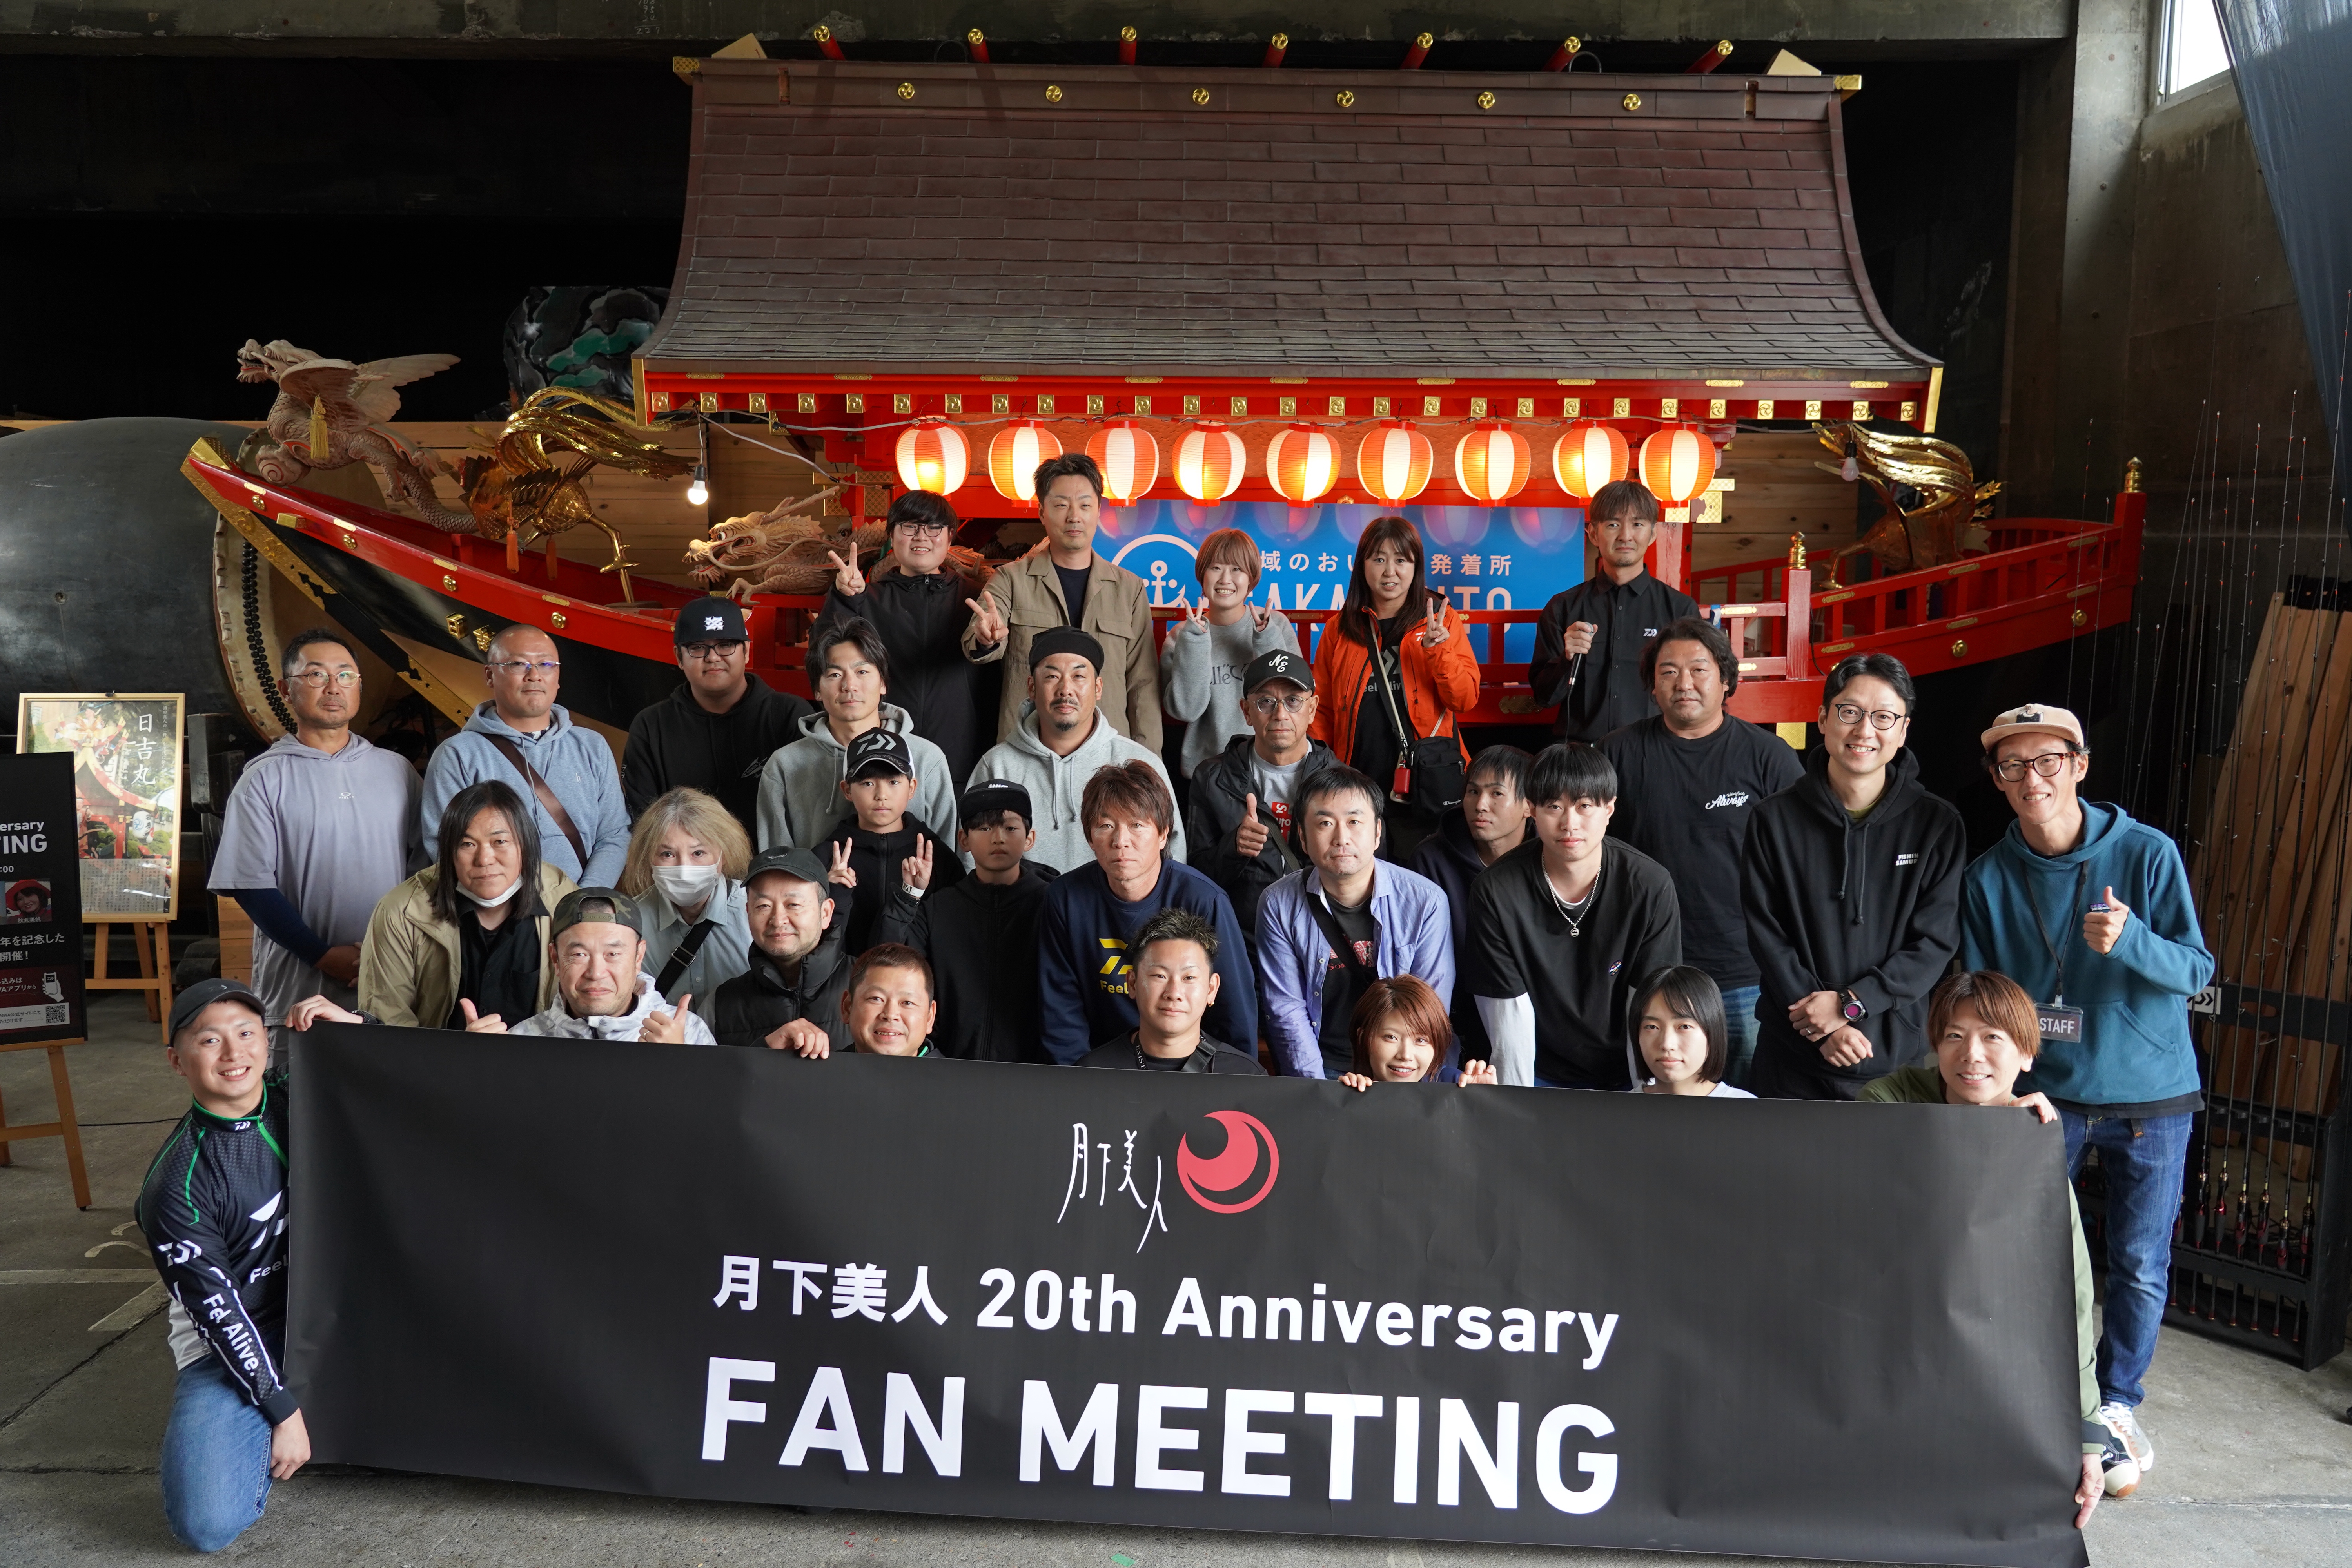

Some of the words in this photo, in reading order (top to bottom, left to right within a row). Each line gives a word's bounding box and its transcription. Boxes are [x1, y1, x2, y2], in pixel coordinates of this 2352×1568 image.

[1431, 554, 1512, 576] 発着所
[131, 713, 157, 785] 日吉丸
[1705, 794, 1749, 810] Always
[0, 833, 47, 854] ING
[0, 933, 65, 947] 年を記念した
[1100, 980, 1129, 994] Feel
[2039, 1017, 2075, 1034] STAFF
[1135, 1045, 1147, 1070] EXIST
[1057, 1123, 1168, 1254] 月下美人
[250, 1254, 289, 1284] Feel
[713, 1255, 948, 1325] 月下美人
[977, 1268, 1136, 1333] 20th
[1161, 1277, 1619, 1370] Anniversary
[222, 1322, 260, 1377] Alive.
[702, 1357, 965, 1477] FAN
[1019, 1380, 1618, 1514] MEETING
